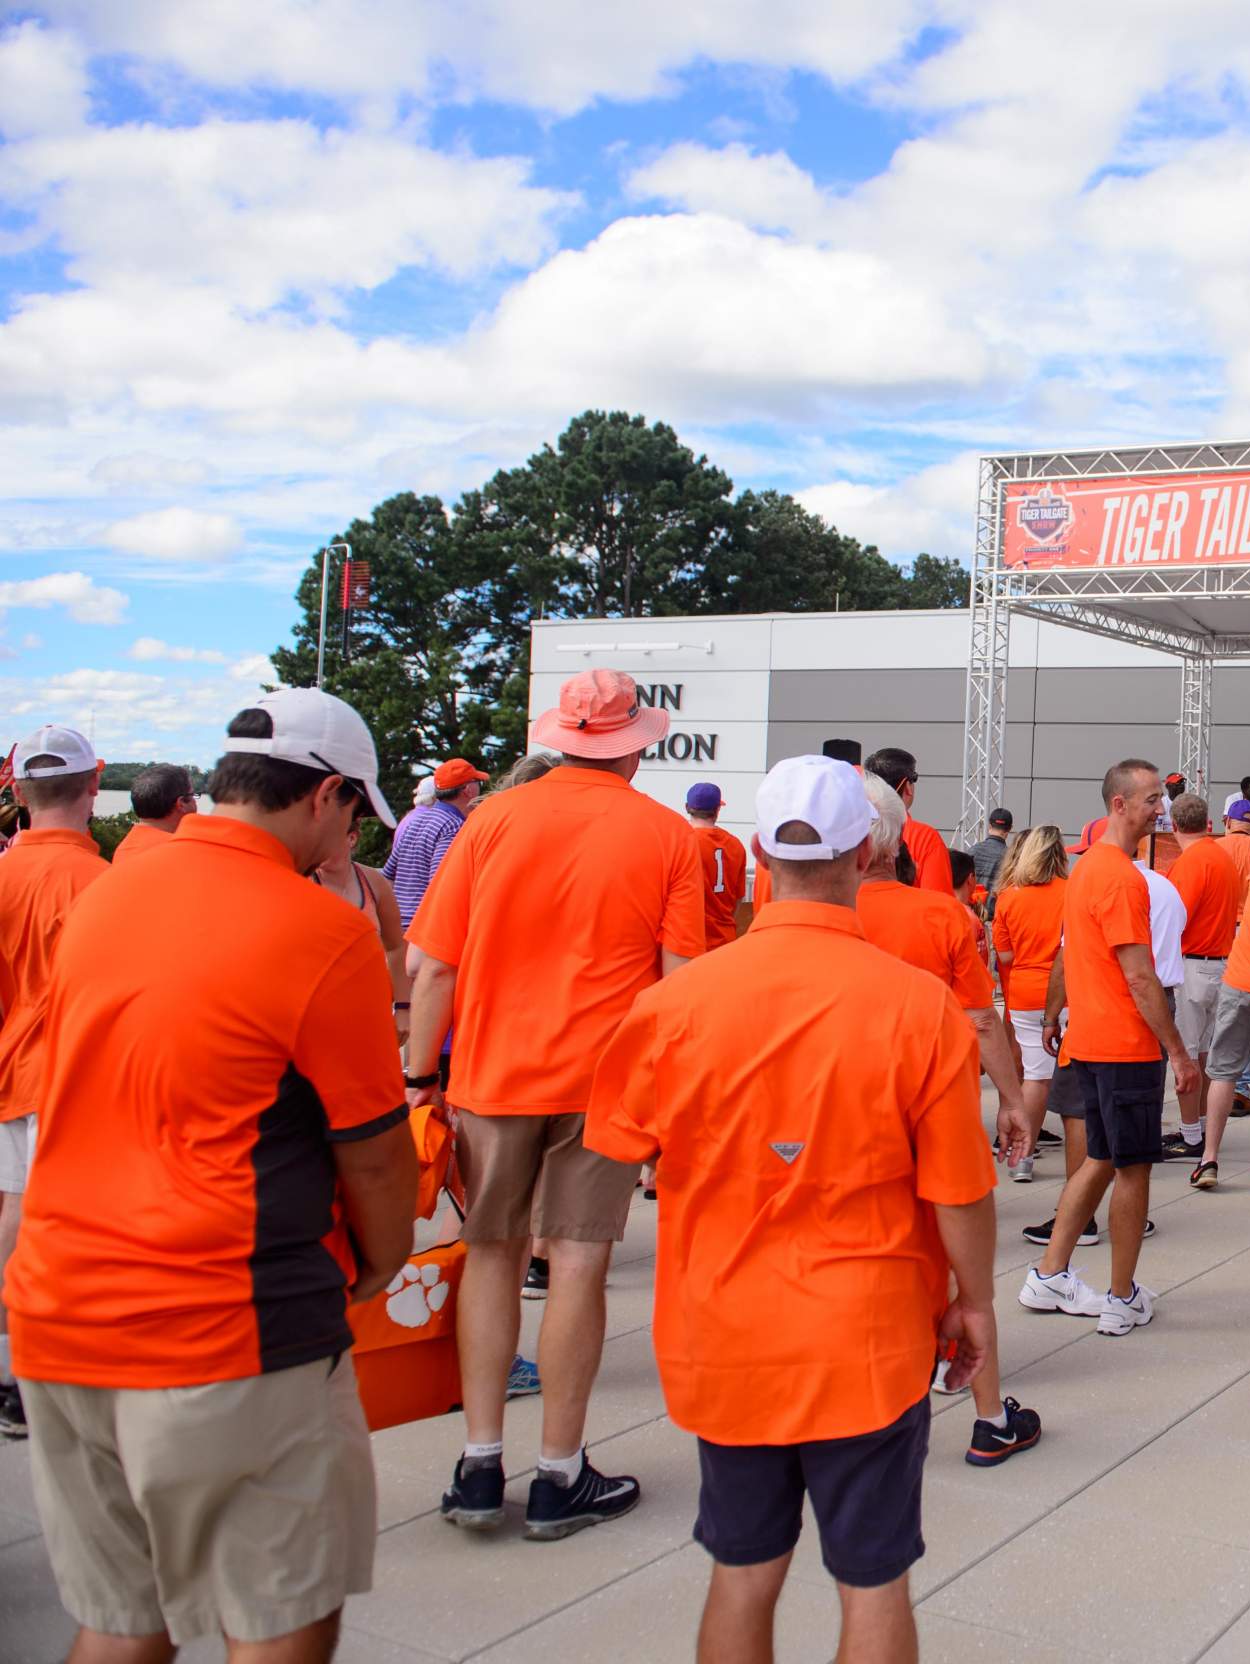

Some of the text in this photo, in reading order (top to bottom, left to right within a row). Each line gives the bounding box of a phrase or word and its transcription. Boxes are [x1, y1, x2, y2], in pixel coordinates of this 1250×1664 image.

[1021, 507, 1069, 521] TIGER TAILGATE
[1097, 491, 1189, 567] TIGER
[713, 848, 725, 893] 1
